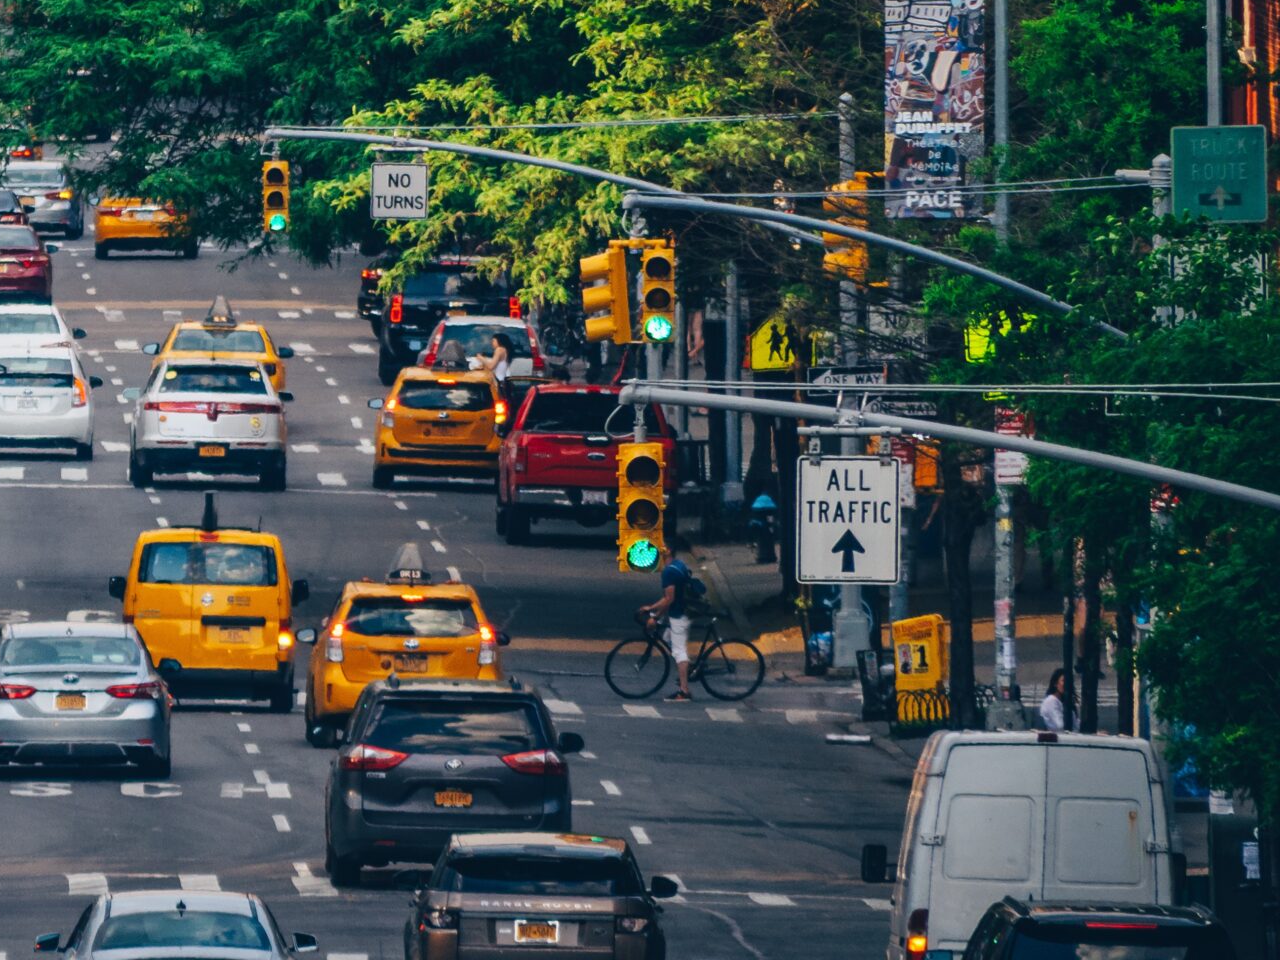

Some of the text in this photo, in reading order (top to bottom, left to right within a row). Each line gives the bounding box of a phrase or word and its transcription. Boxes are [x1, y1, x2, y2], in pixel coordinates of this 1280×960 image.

[895, 111, 933, 122] JEAN
[895, 123, 972, 134] DUBUFFET
[1190, 138, 1247, 155] TRUCK
[1191, 162, 1248, 180] ROUTE
[388, 173, 411, 188] NO
[375, 195, 424, 210] TURNS
[906, 191, 962, 207] PACE
[824, 375, 880, 384] ONE WAY
[827, 469, 871, 491] ALL
[806, 501, 892, 524] TRAFFIC
[480, 900, 532, 908] RANGE
